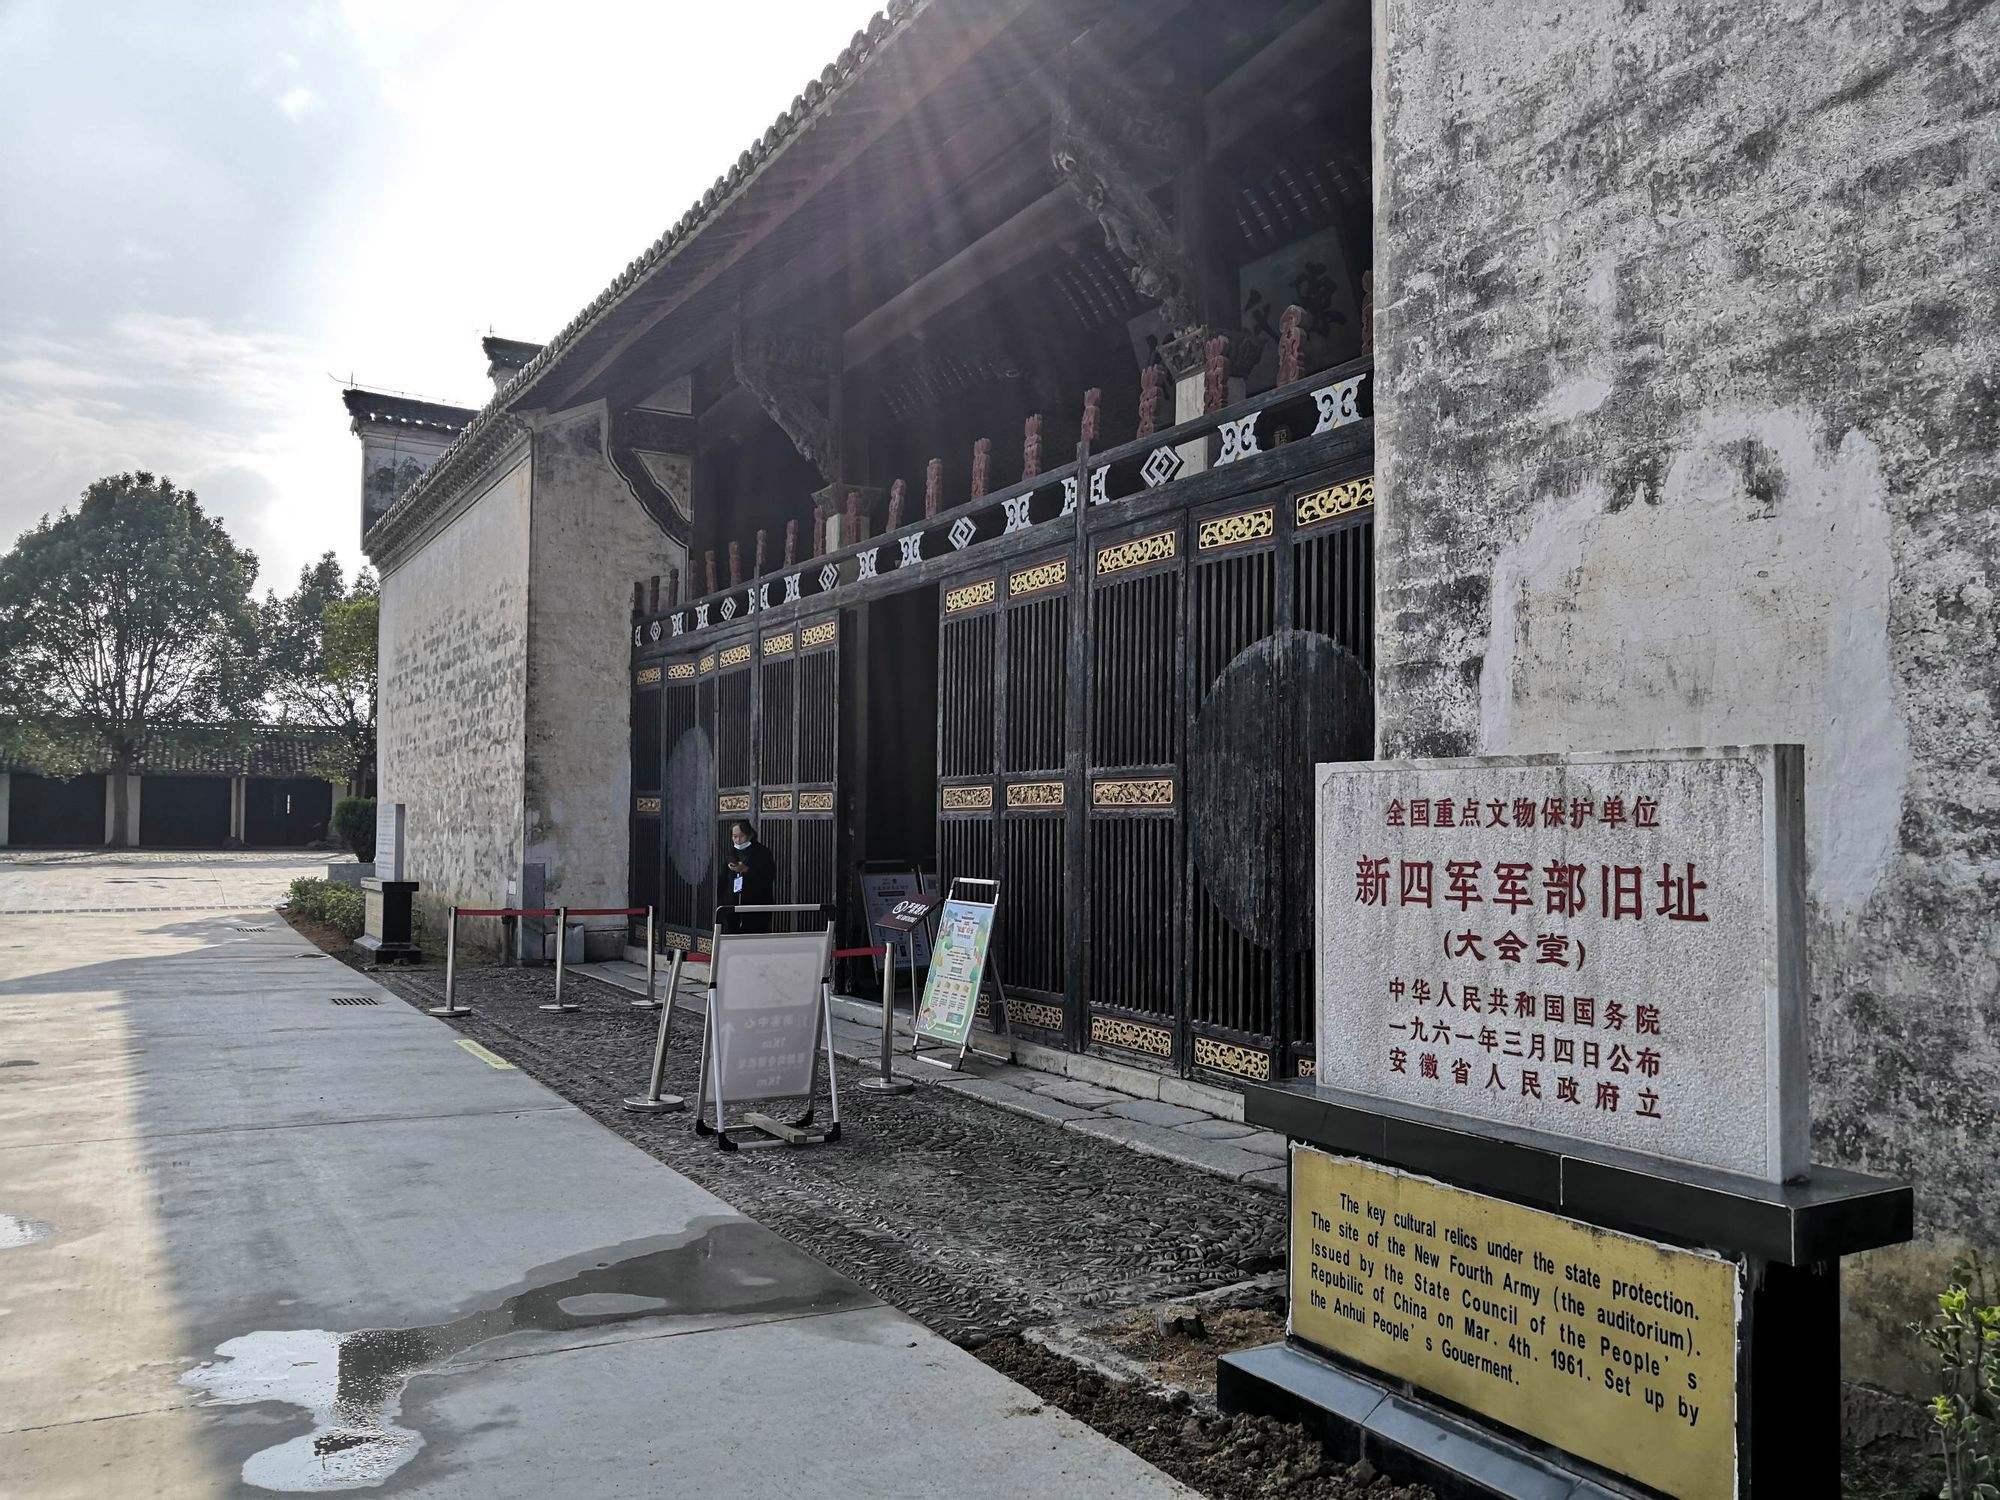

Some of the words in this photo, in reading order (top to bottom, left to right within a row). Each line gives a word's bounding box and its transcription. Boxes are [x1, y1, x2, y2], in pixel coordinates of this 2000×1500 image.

[1386, 795, 1659, 829] 全国重点文物保护单位
[1355, 855, 1709, 922] 新四军军部旧址
[1389, 976, 1661, 1035] 中华人民共和国国务院
[1389, 1016, 1661, 1078] 一九六一年三月四日公布
[1389, 1047, 1662, 1119] 安徽省人民政府立
[1311, 1211, 1330, 1233] The
[1339, 1223, 1359, 1242] site
[1368, 1231, 1379, 1248] of
[1388, 1236, 1405, 1257] the
[1415, 1243, 1440, 1268] New
[1450, 1255, 1493, 1286] Fourth
[1503, 1273, 1540, 1306] Army
[1554, 1286, 1585, 1317] (the
[1597, 1307, 1700, 1357] auditorium).
[1340, 1193, 1359, 1214] The
[1367, 1201, 1385, 1226] key
[1394, 1212, 1436, 1238] cultural
[1444, 1226, 1477, 1251] relics
[1487, 1241, 1523, 1264] under
[1533, 1252, 1554, 1274] the
[1566, 1264, 1600, 1289] state
[1613, 1279, 1699, 1320] protection.
[1311, 1238, 1350, 1266] Issued
[1360, 1253, 1374, 1278] by
[1385, 1263, 1403, 1285] the
[1415, 1272, 1449, 1301] State
[1462, 1289, 1518, 1326] Council
[1530, 1316, 1545, 1335] of
[1560, 1324, 1585, 1349] the
[1311, 1290, 1326, 1309] the
[1334, 1298, 1365, 1324] Anhui
[1373, 1287, 1384, 1303] of
[1394, 1292, 1427, 1320] China
[1438, 1312, 1453, 1329] on
[1605, 1368, 1631, 1396] Set
[1645, 1387, 1664, 1412] up
[1679, 1395, 1699, 1426] by
